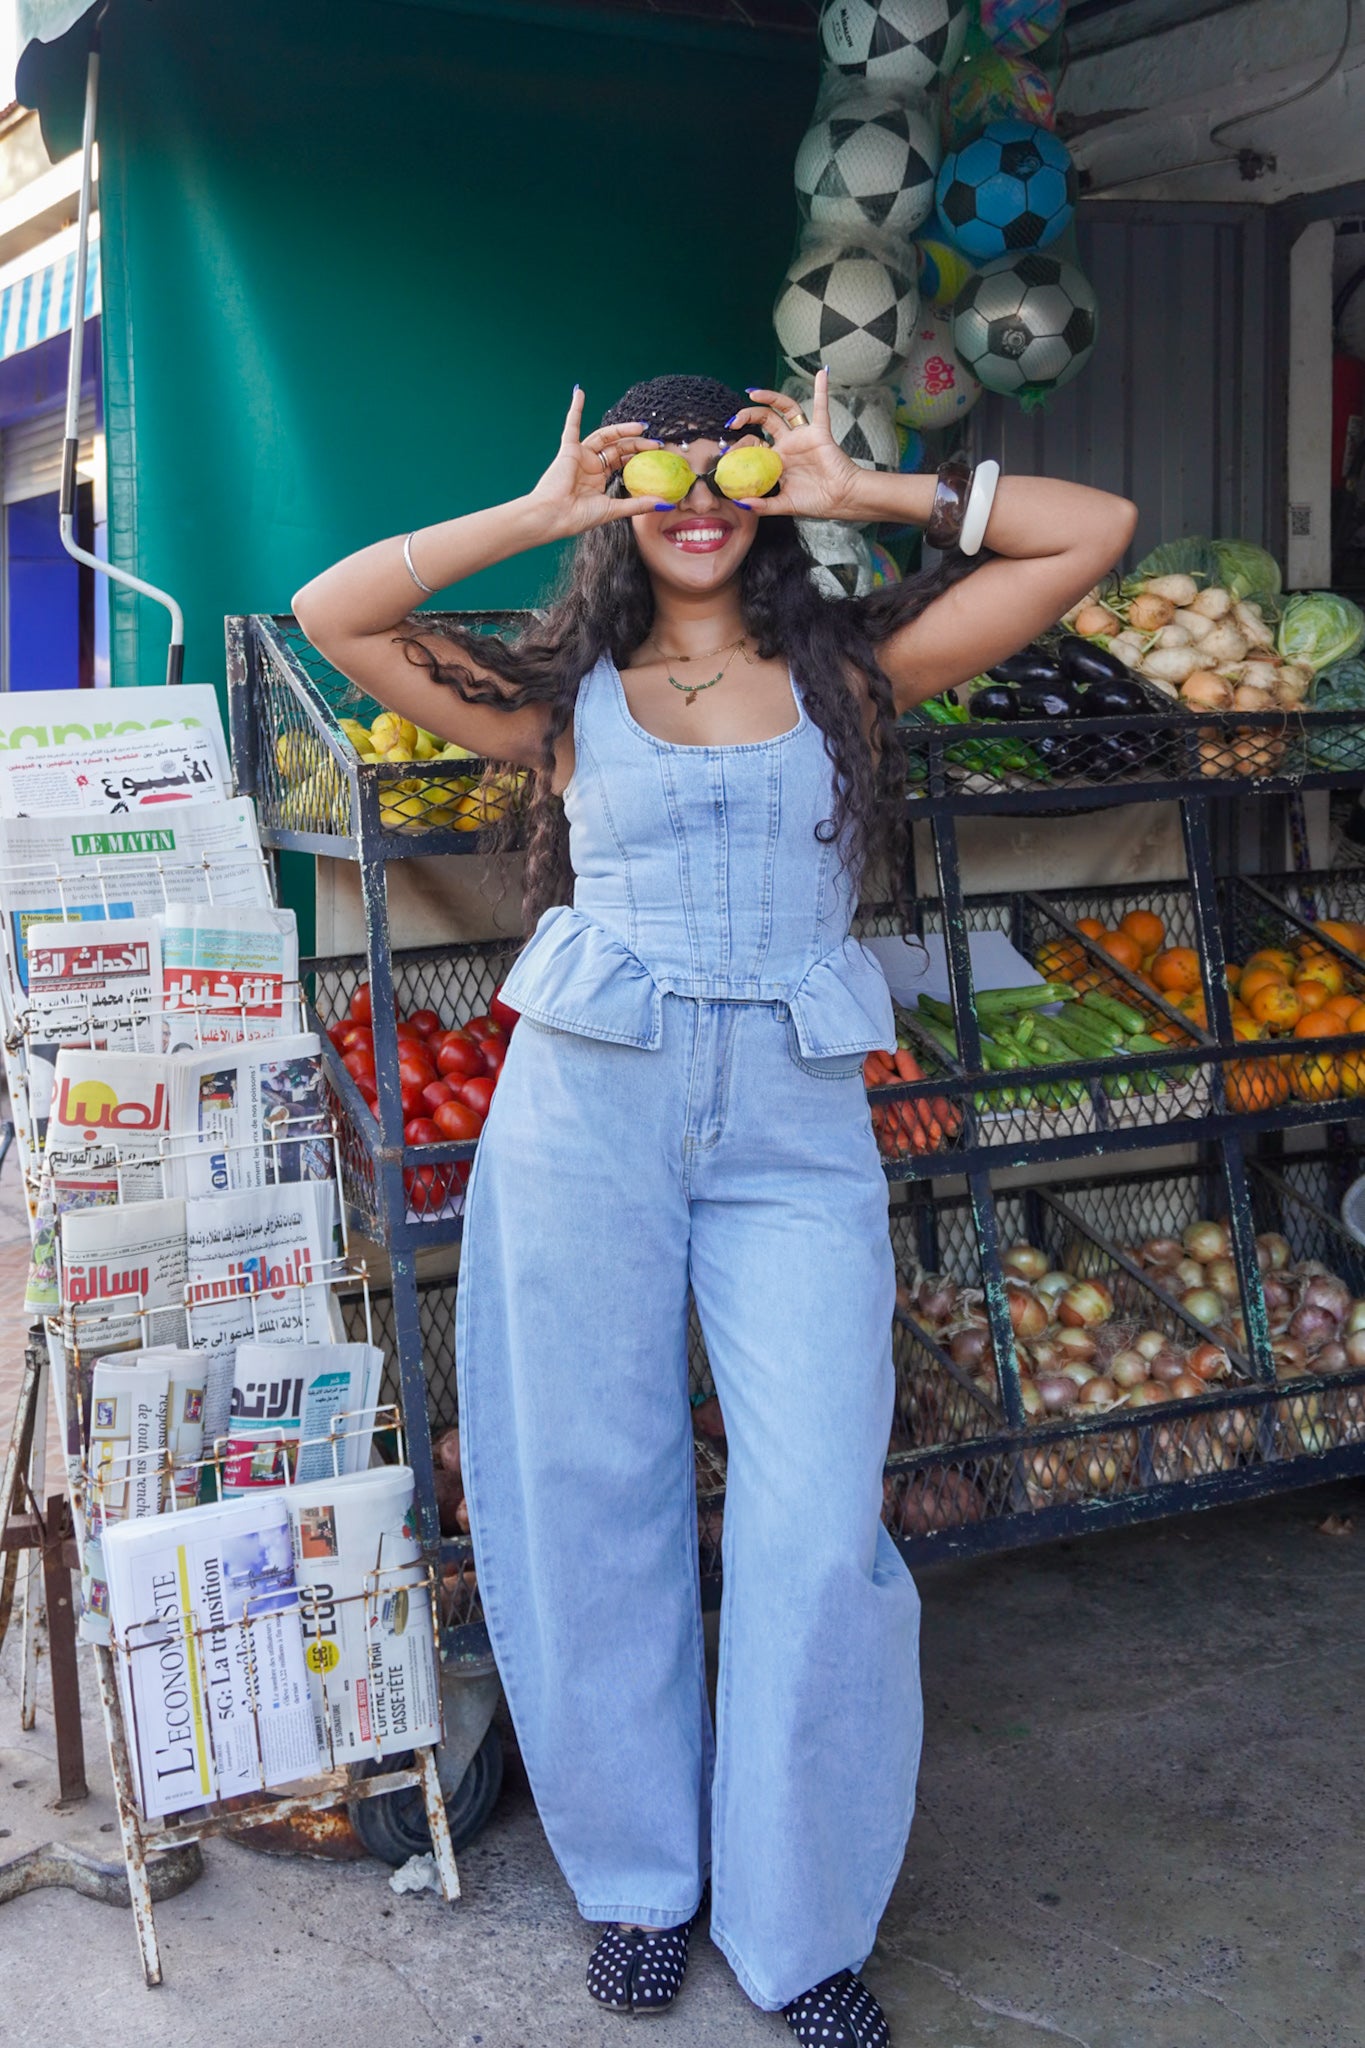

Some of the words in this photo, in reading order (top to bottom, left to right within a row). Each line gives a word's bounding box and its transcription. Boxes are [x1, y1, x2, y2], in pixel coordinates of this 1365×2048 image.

[100, 754, 213, 799] الأسبوع
[76, 834, 104, 855] LE
[72, 943, 149, 976] الأحداث
[91, 993, 125, 1007] محمد
[164, 974, 276, 1014] الأخبار
[249, 1070, 259, 1103] poissons
[250, 1119, 258, 1129] de
[69, 1265, 149, 1303] رسالة
[252, 1248, 313, 1300] النهار
[211, 1328, 227, 1348] إلى
[230, 1327, 255, 1345] يدعو
[258, 1319, 279, 1334] الملك
[138, 1403, 152, 1419] de
[202, 1557, 226, 1652] transition
[210, 1655, 232, 1688] La
[217, 1688, 235, 1720] 5G:
[386, 1664, 408, 1735] CASSE-TÊTE
